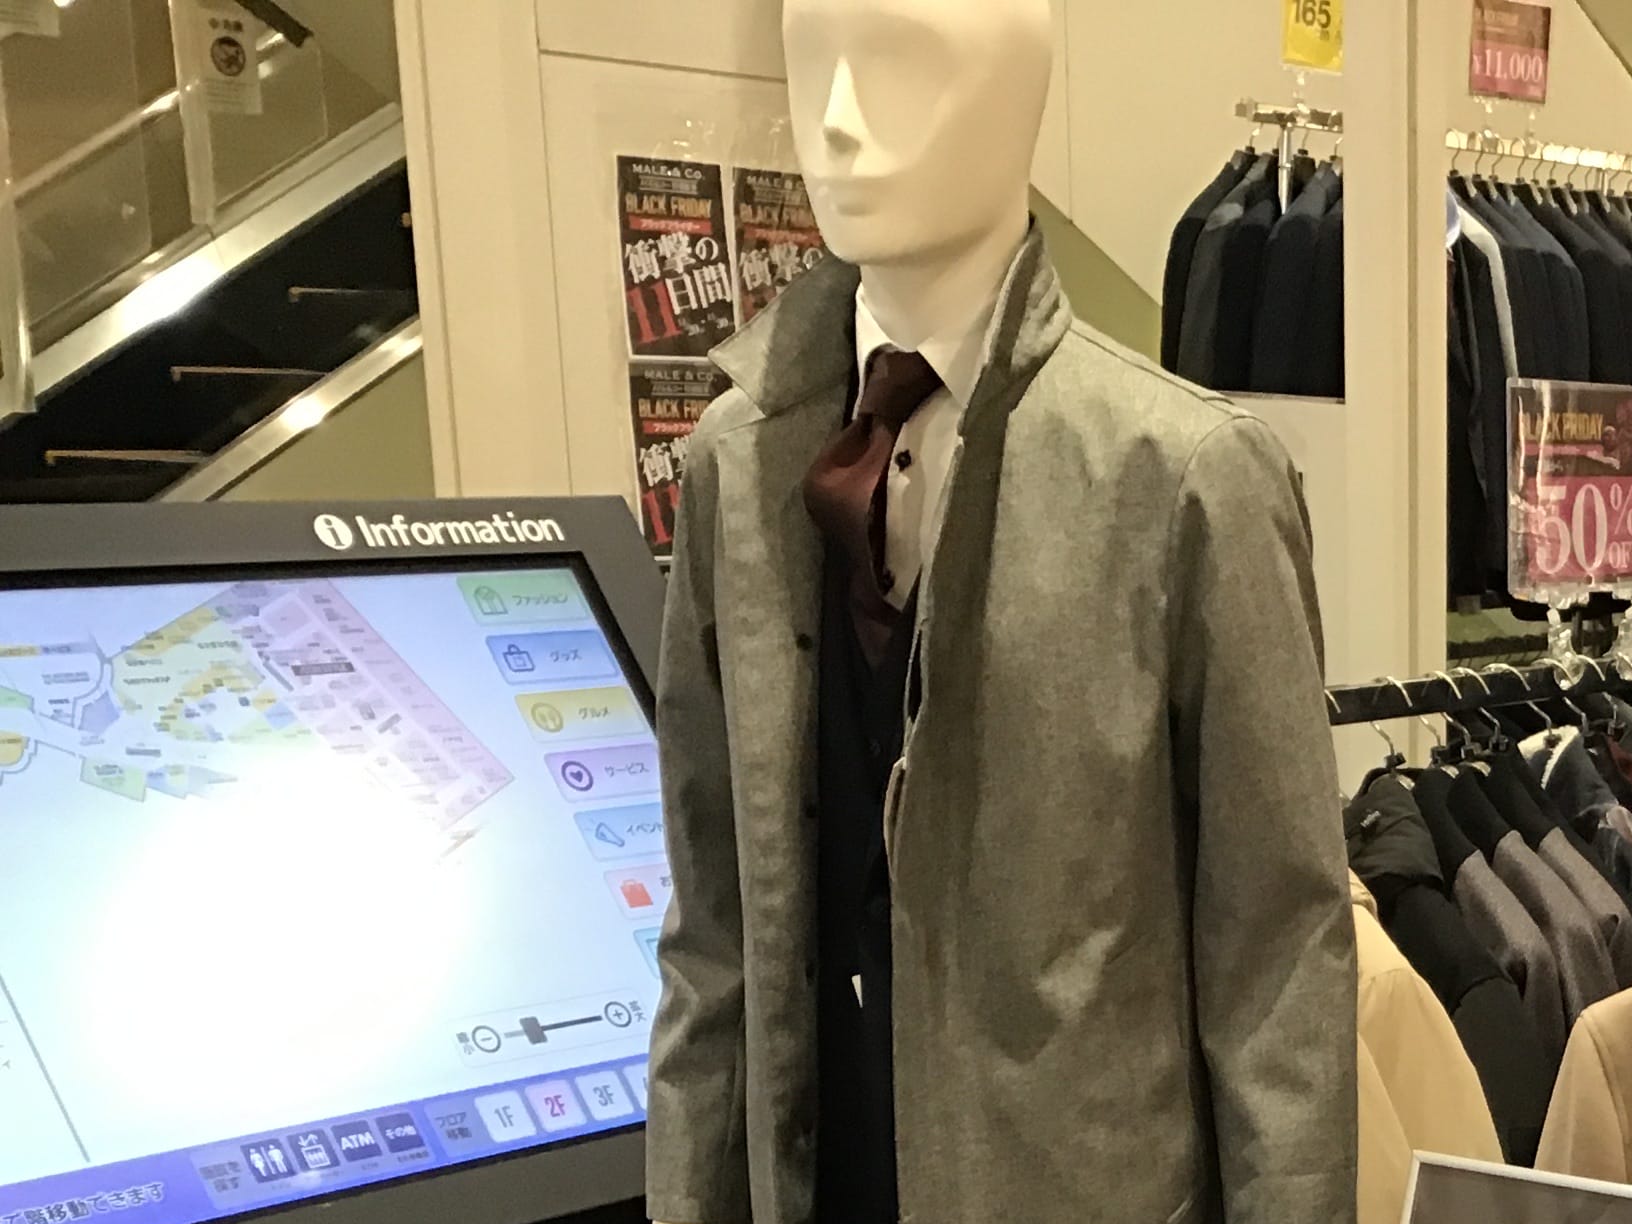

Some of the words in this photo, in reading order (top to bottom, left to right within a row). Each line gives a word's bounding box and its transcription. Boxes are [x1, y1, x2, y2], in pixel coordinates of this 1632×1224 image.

[1292, 0, 1332, 30] 165
[356, 511, 565, 549] Information
[511, 593, 569, 607] ファッション
[604, 762, 650, 778] サービス
[544, 1094, 567, 1119] 2F
[593, 1084, 616, 1108] 3F
[435, 1111, 468, 1128] フロア
[494, 1105, 517, 1129] 1F
[340, 1130, 376, 1151] ATM
